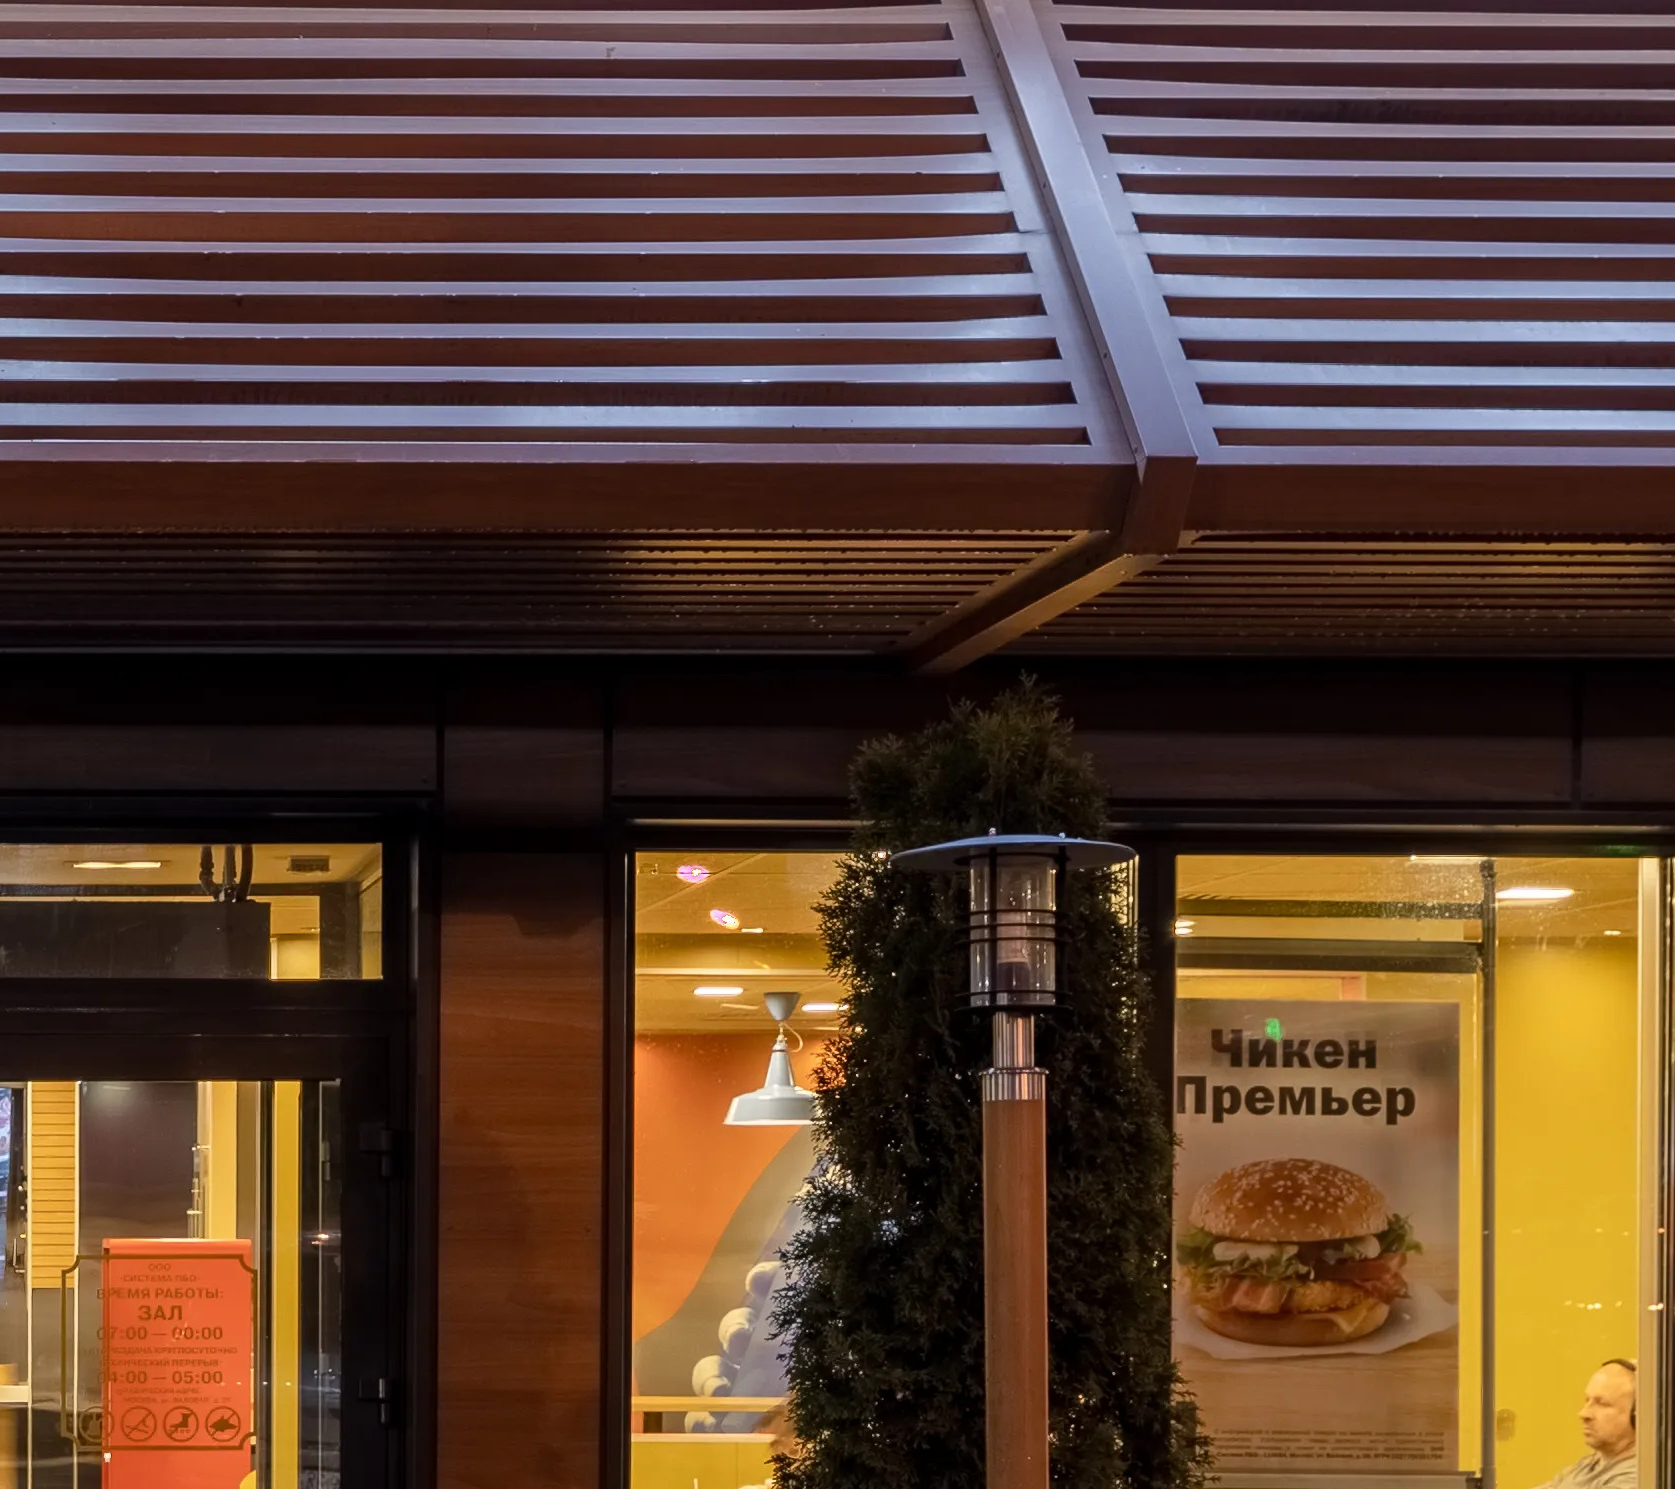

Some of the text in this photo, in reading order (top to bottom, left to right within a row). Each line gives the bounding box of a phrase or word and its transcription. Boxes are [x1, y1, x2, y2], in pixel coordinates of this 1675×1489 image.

[1211, 1029, 1377, 1069] Чикен
[1177, 1075, 1416, 1125] Премьер
[96, 1287, 224, 1300] ВРЕМЯ РАБОТЫ:
[138, 1305, 183, 1321] ЗАЛ
[96, 1326, 147, 1340] 07:00
[172, 1326, 223, 1340] 00:00
[96, 1370, 147, 1384] 04:00
[172, 1370, 223, 1384] 05:00
